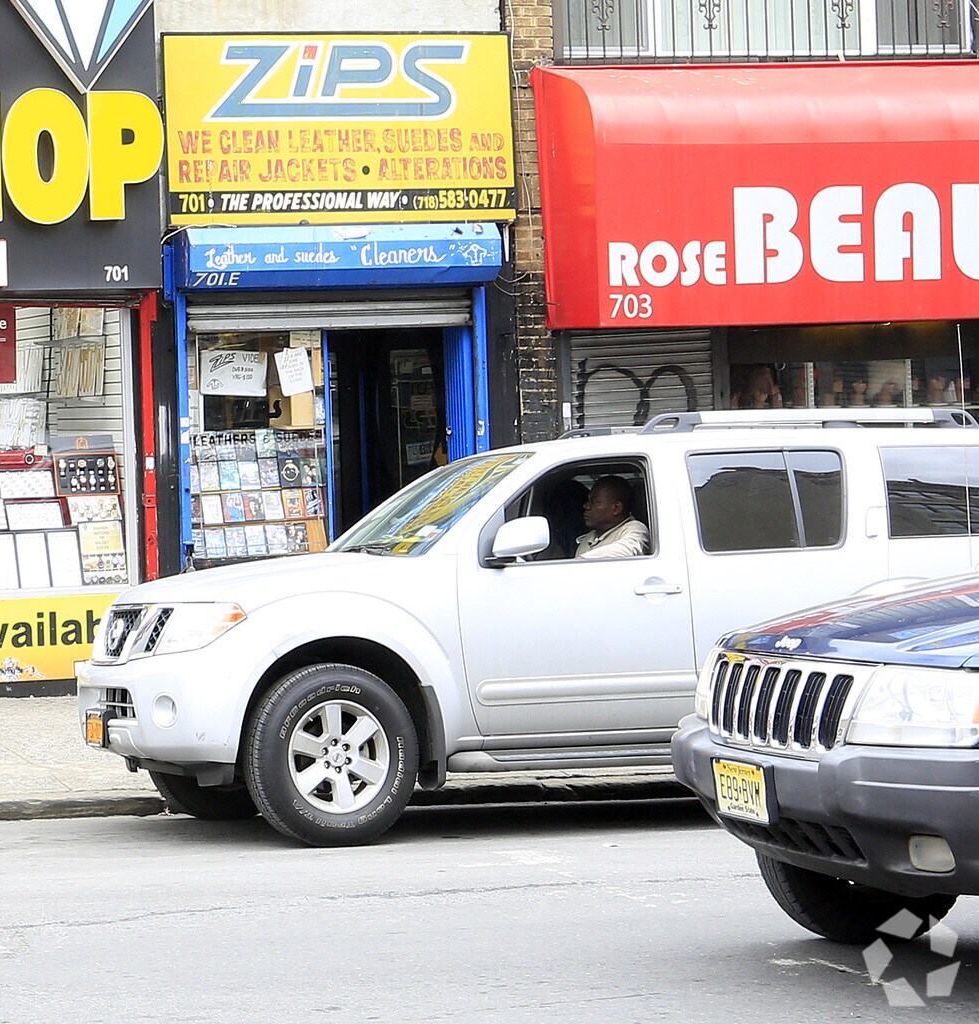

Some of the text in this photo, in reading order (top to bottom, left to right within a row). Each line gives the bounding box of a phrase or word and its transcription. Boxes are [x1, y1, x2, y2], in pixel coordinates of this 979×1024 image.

[178, 130, 212, 154] WE
[219, 129, 279, 154] CLEAN
[469, 132, 505, 152] AND
[178, 156, 507, 183] REPAIR JACKETS ALTERATIONS
[178, 193, 206, 213] 701
[221, 193, 250, 211] THE
[251, 191, 364, 212] PROFESSIONAL
[367, 191, 401, 209] WAY
[264, 245, 289, 264] and
[294, 243, 341, 264] suedes
[608, 240, 727, 288] ROSE
[103, 264, 131, 283] 701
[608, 293, 653, 319] 703
[242, 353, 260, 364] VIDE
[193, 432, 256, 446] LEATHERS
[775, 636, 802, 650] Jeep
